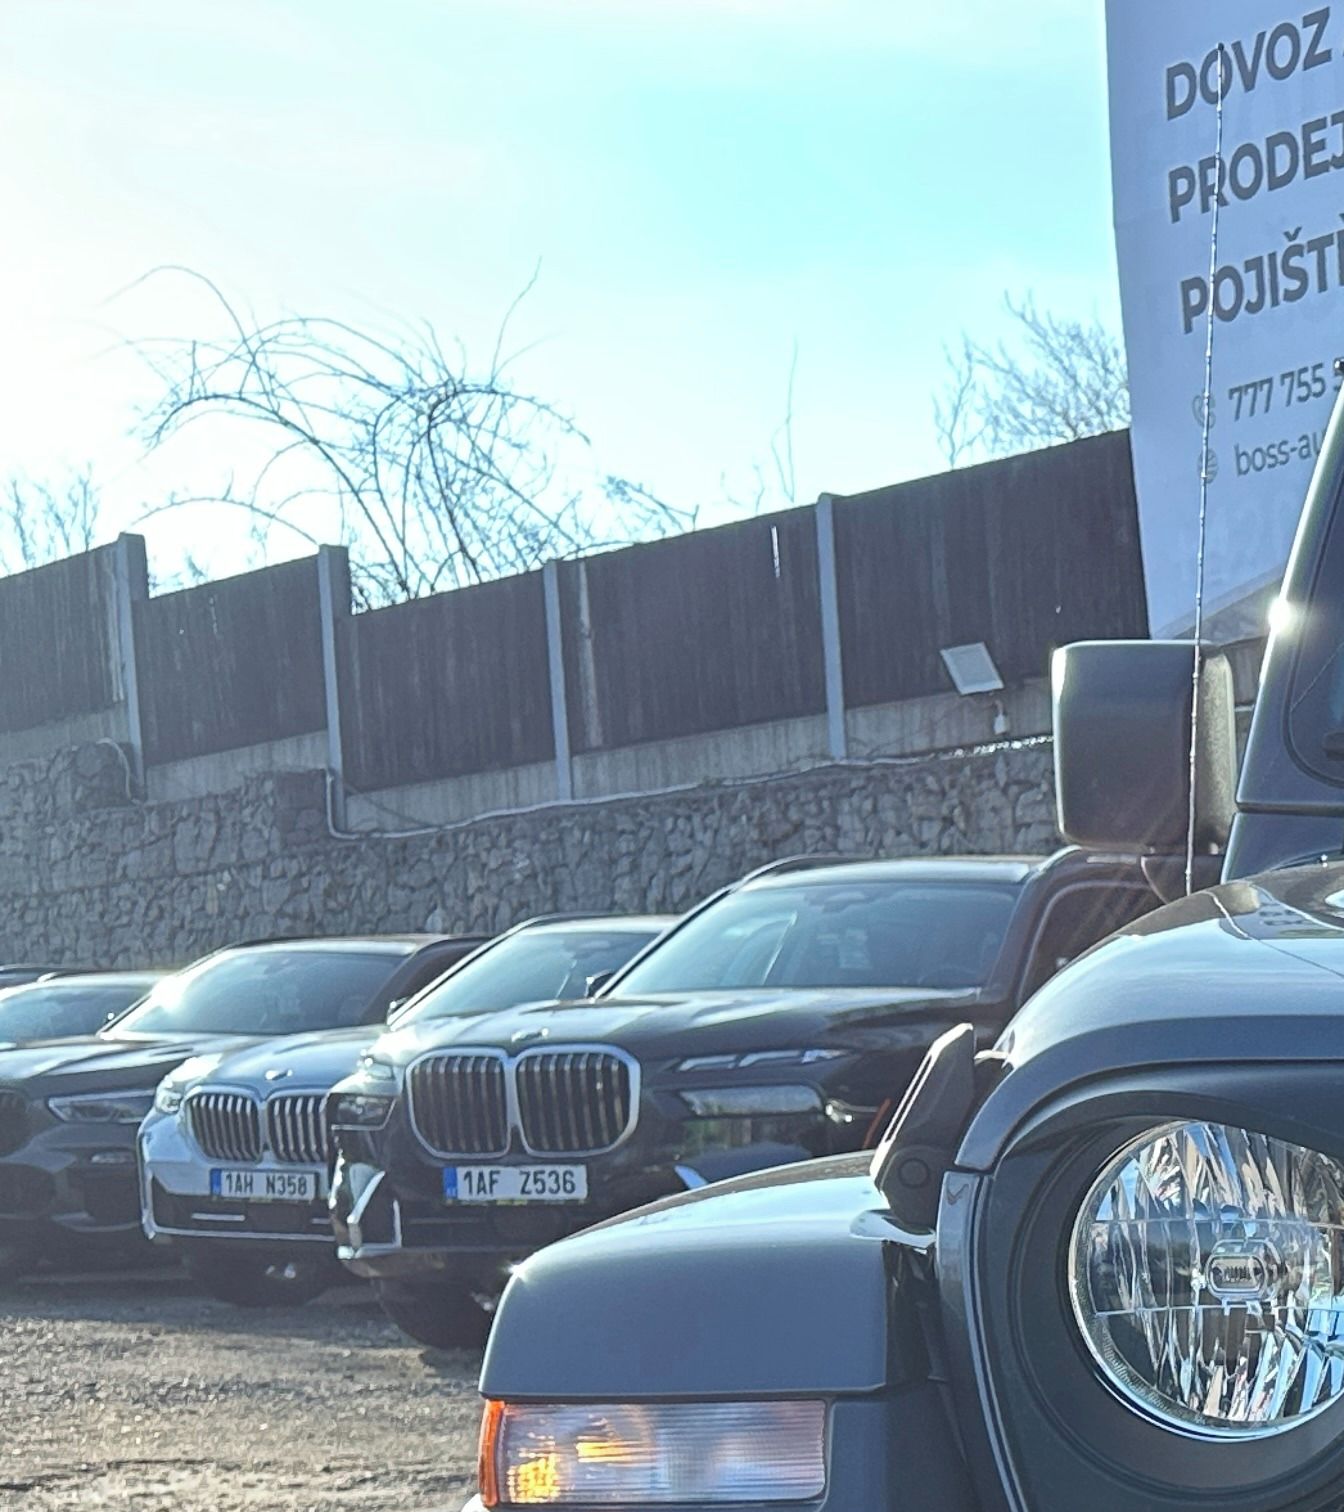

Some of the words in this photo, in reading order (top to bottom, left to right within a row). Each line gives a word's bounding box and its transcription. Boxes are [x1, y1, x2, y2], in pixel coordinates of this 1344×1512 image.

[1166, 7, 1332, 120] DOVOZ
[1228, 377, 1274, 422] 777
[1280, 363, 1327, 407] 755
[225, 1172, 255, 1195] 1AH
[266, 1174, 308, 1196] N358
[464, 1170, 501, 1196] 1AF
[518, 1169, 576, 1196] Z536
